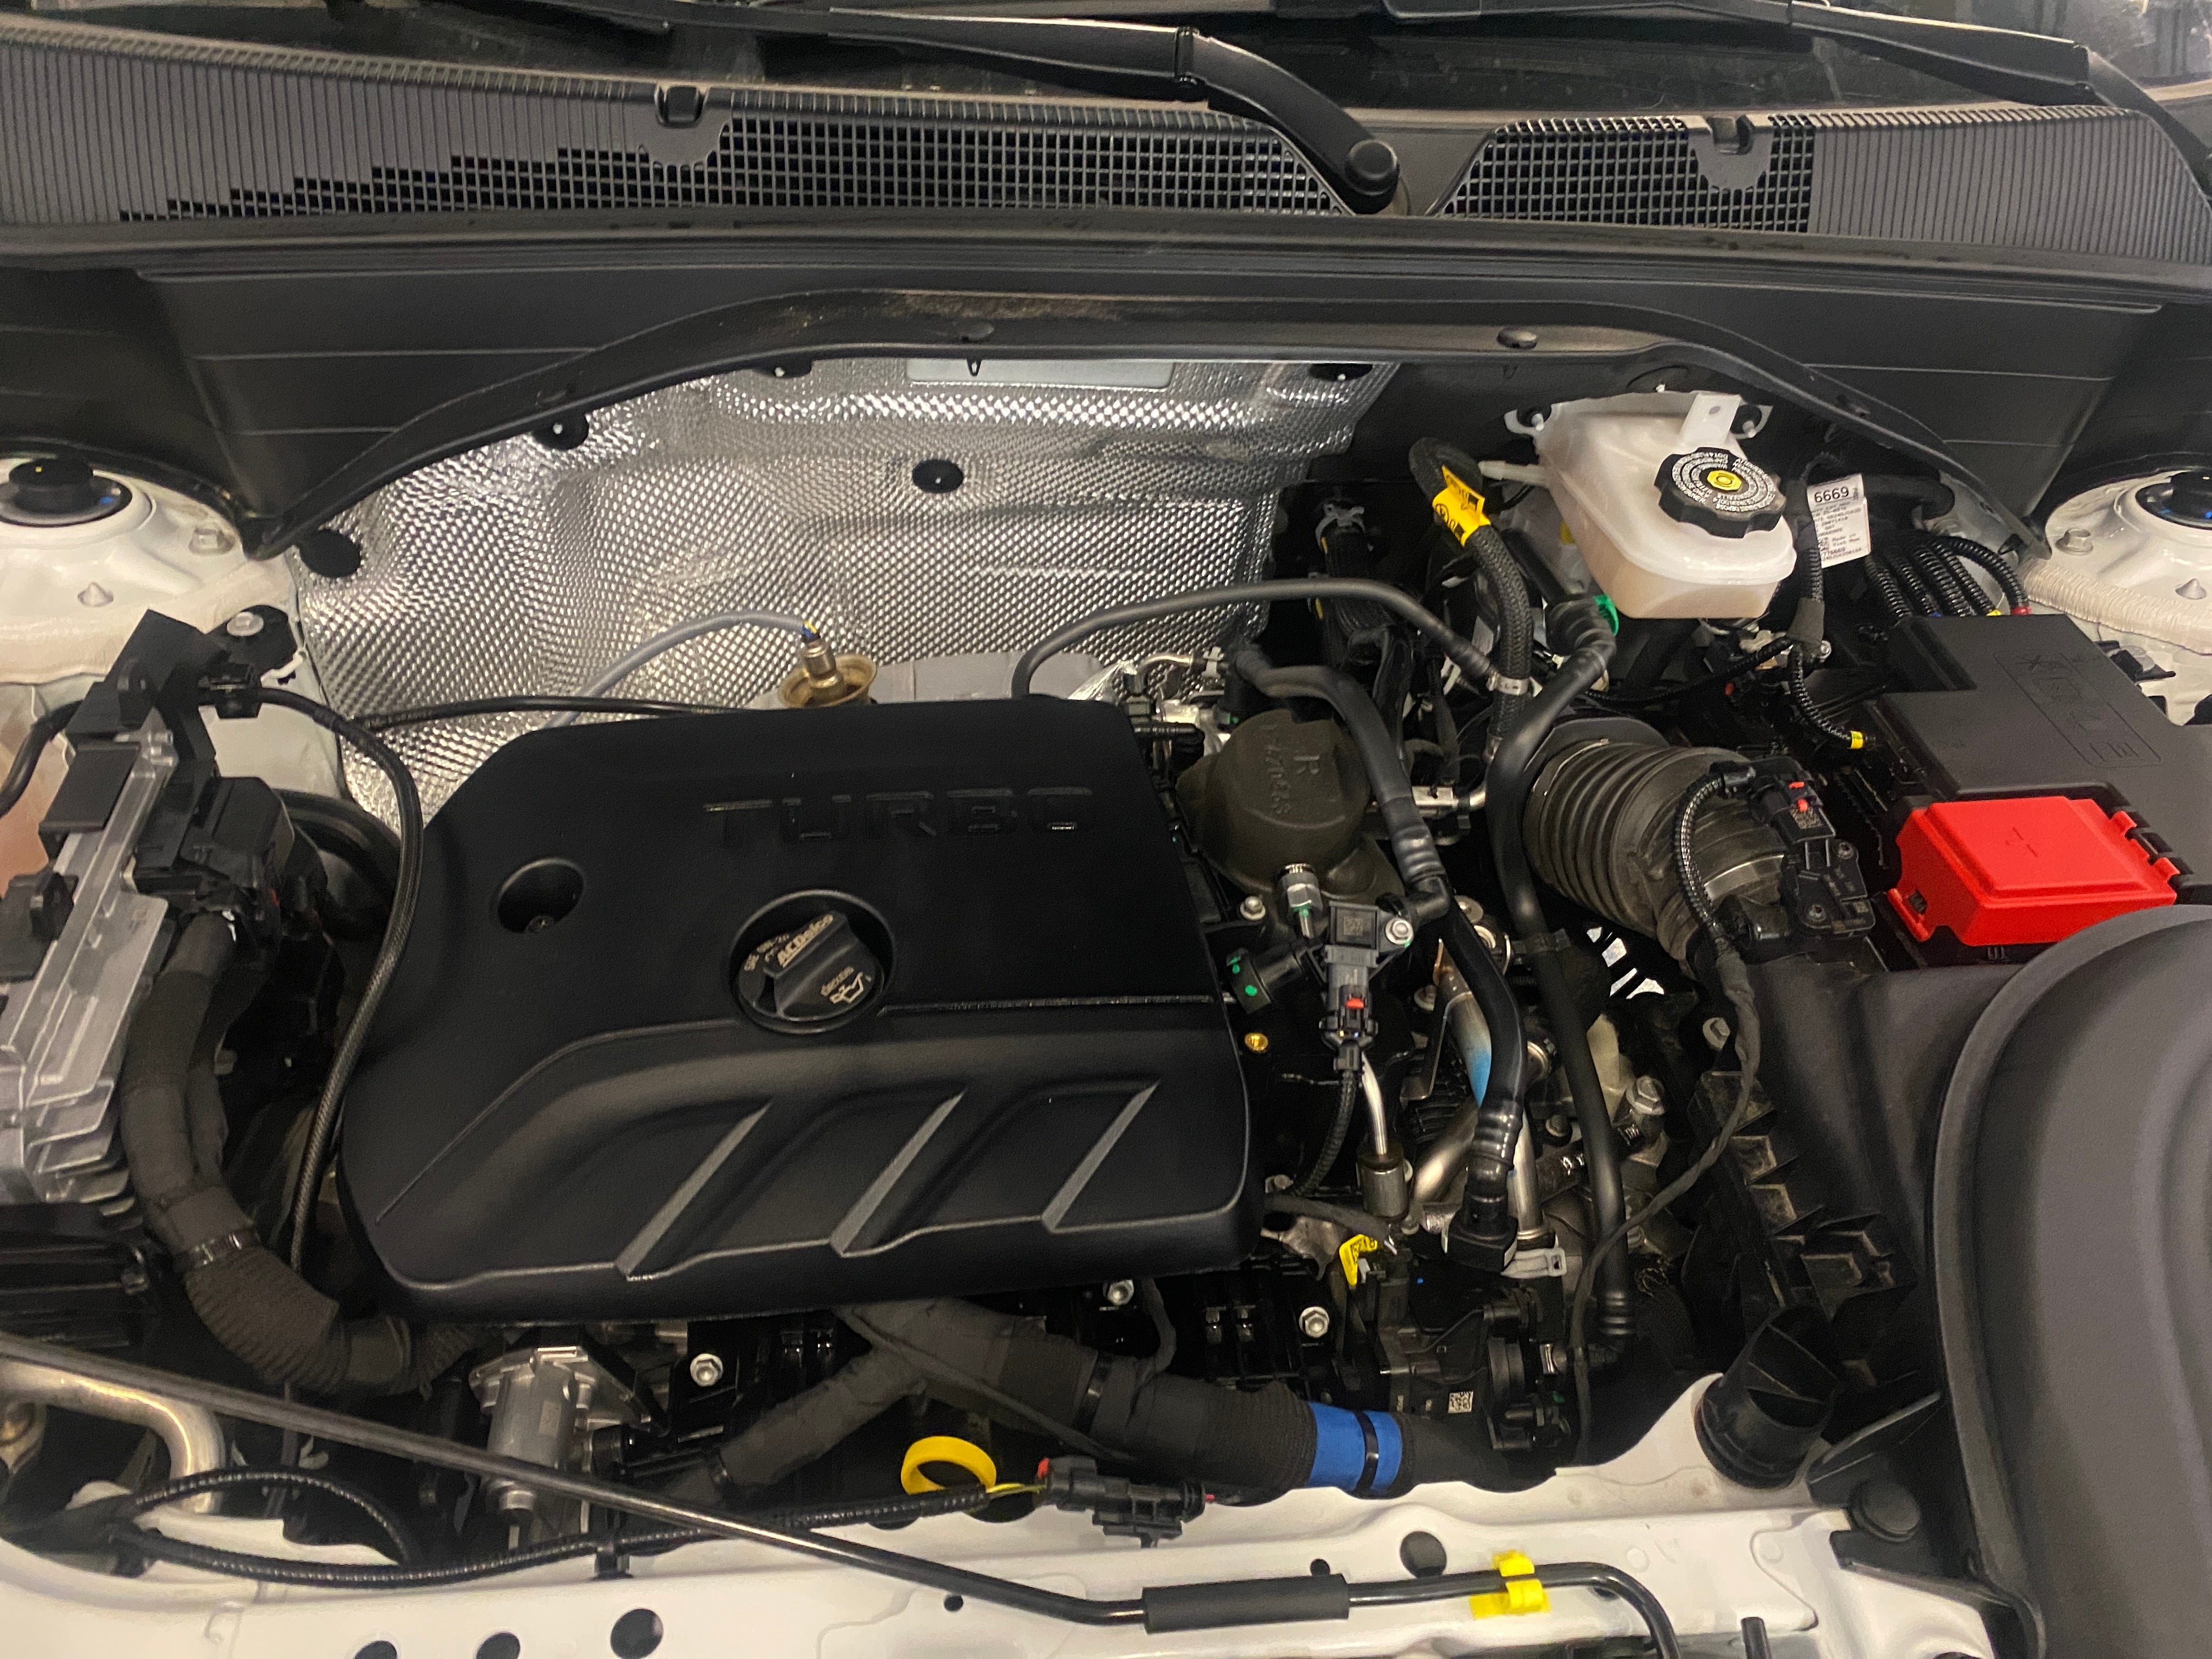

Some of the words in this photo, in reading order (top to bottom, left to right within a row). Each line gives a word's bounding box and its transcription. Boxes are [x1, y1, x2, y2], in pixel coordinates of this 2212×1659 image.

[1814, 486, 1849, 503] 6669
[702, 786, 1094, 848] TURBO
[777, 913, 834, 967] ACDelco
